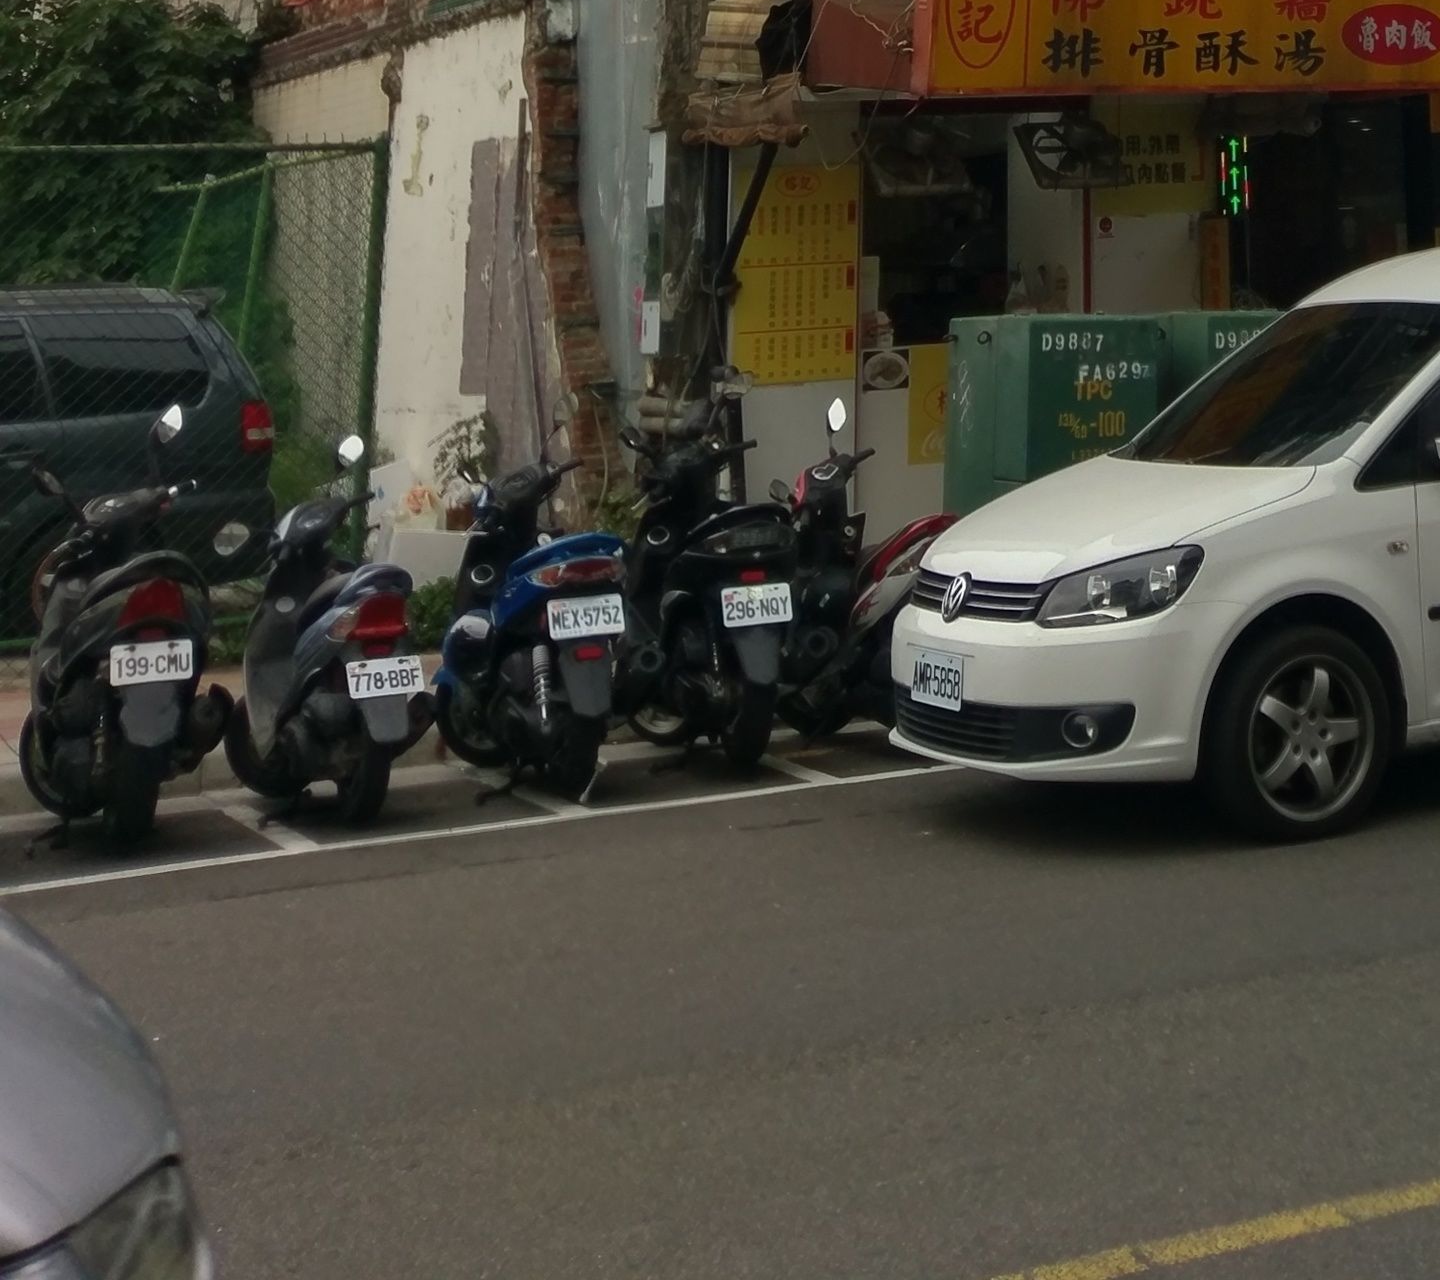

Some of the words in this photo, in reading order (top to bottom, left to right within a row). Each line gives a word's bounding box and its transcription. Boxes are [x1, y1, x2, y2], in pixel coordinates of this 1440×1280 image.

[1357, 16, 1438, 52] 魯肉飯
[1041, 27, 1328, 78] 排骨酥湯
[1074, 380, 1114, 402] TPC
[551, 606, 623, 636] MEX-5752
[723, 597, 791, 623] 296-NQY
[115, 656, 192, 681] 199-CMU
[350, 666, 421, 693] 778-BBF
